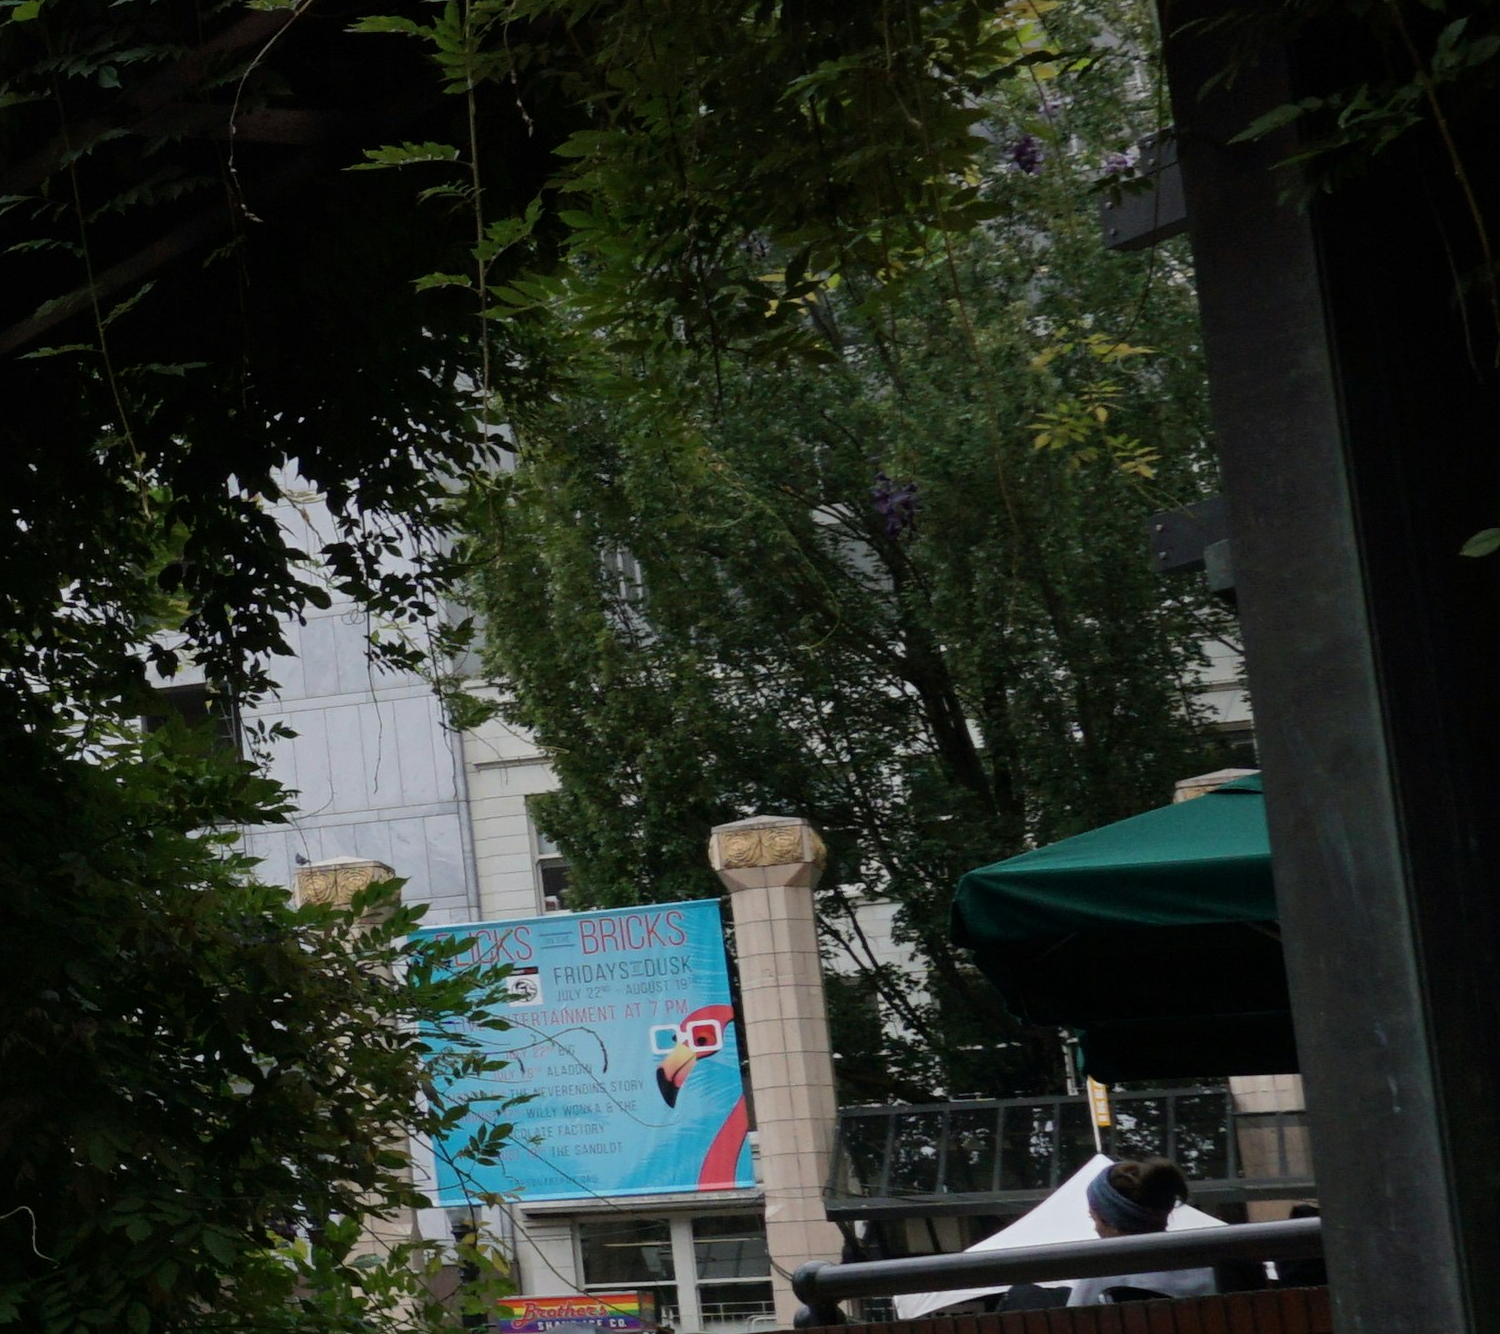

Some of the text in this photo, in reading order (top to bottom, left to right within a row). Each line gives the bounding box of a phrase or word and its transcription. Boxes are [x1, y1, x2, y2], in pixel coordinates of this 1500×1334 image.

[578, 910, 688, 955] BRICKS
[552, 955, 693, 986] FRIDAYS DUSK
[556, 988, 583, 1003] JULY
[625, 980, 669, 996] AUGUST
[623, 1002, 642, 1020] AT
[650, 1000, 658, 1017] 7
[664, 998, 690, 1015] PM
